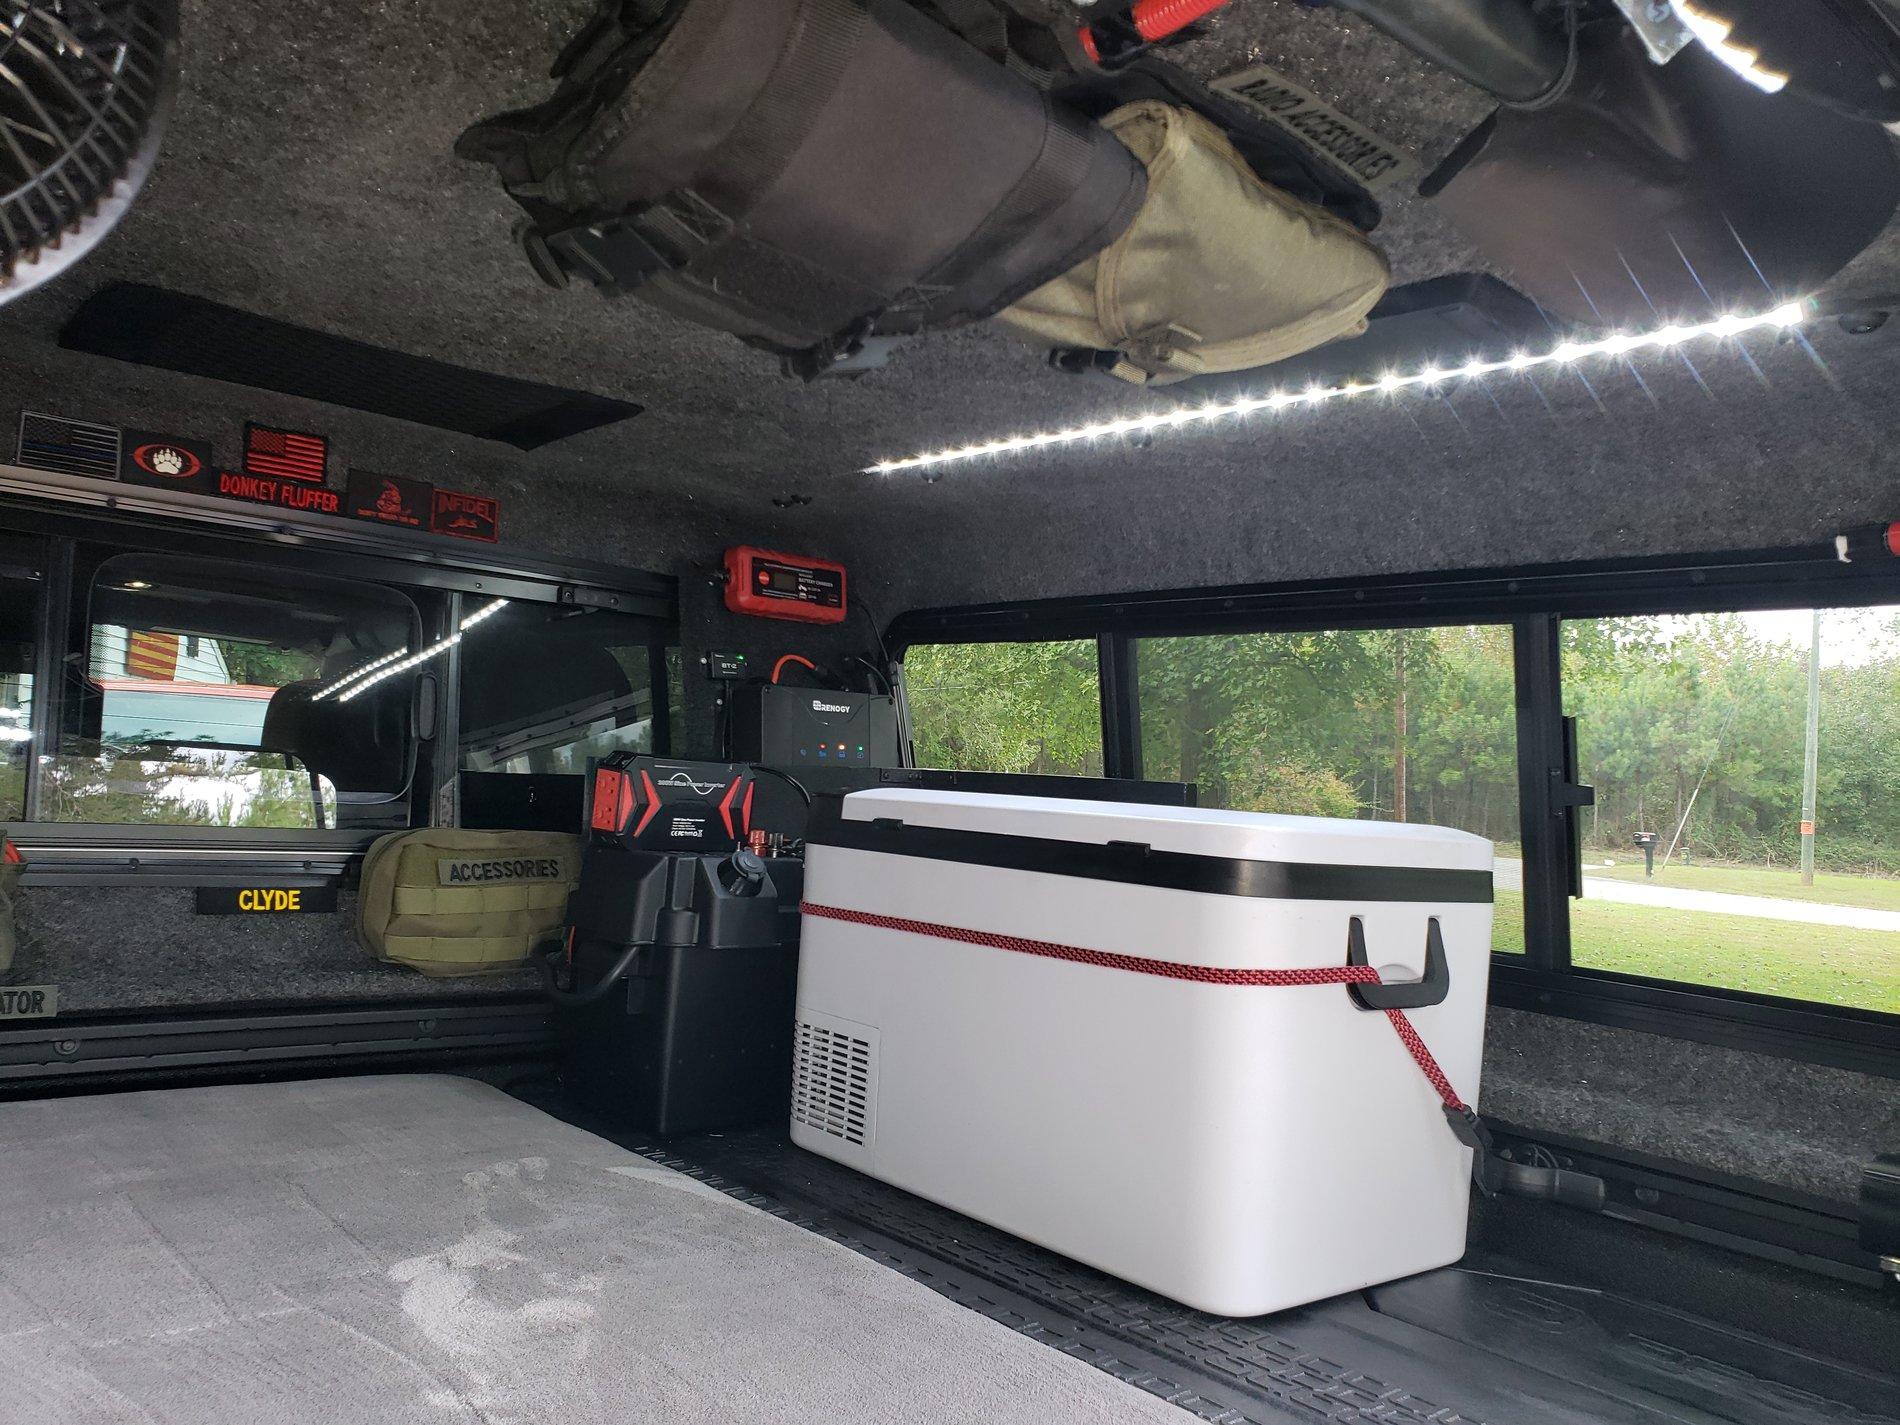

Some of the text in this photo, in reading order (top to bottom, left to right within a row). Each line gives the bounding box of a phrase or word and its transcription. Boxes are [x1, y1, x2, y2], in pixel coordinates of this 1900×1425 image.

[1280, 108, 1399, 182] ACCESSORIES
[219, 472, 339, 513] DONKEY FLUFFER
[821, 703, 851, 714] RENOGY
[449, 859, 560, 882] ACCESSORIES
[239, 889, 301, 910] CLYDE
